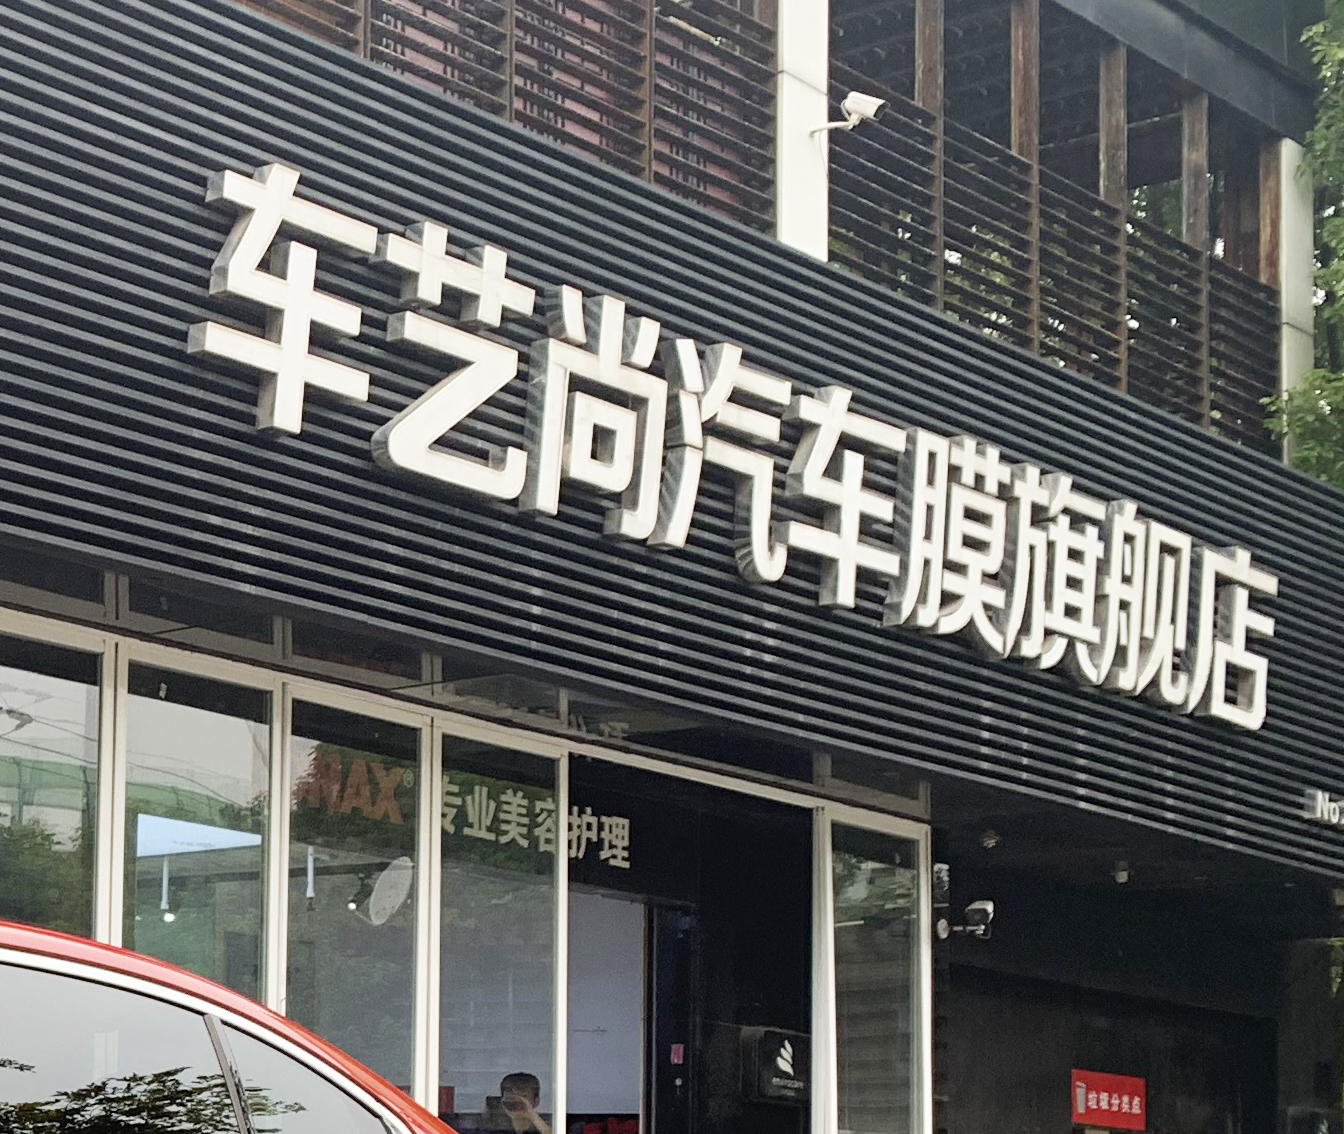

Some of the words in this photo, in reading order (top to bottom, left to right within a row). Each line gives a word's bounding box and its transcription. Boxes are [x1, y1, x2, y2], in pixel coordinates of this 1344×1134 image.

[187, 162, 1280, 731] 车艺尚汽车膜旗舰店
[442, 774, 631, 869] 专业美容护理
